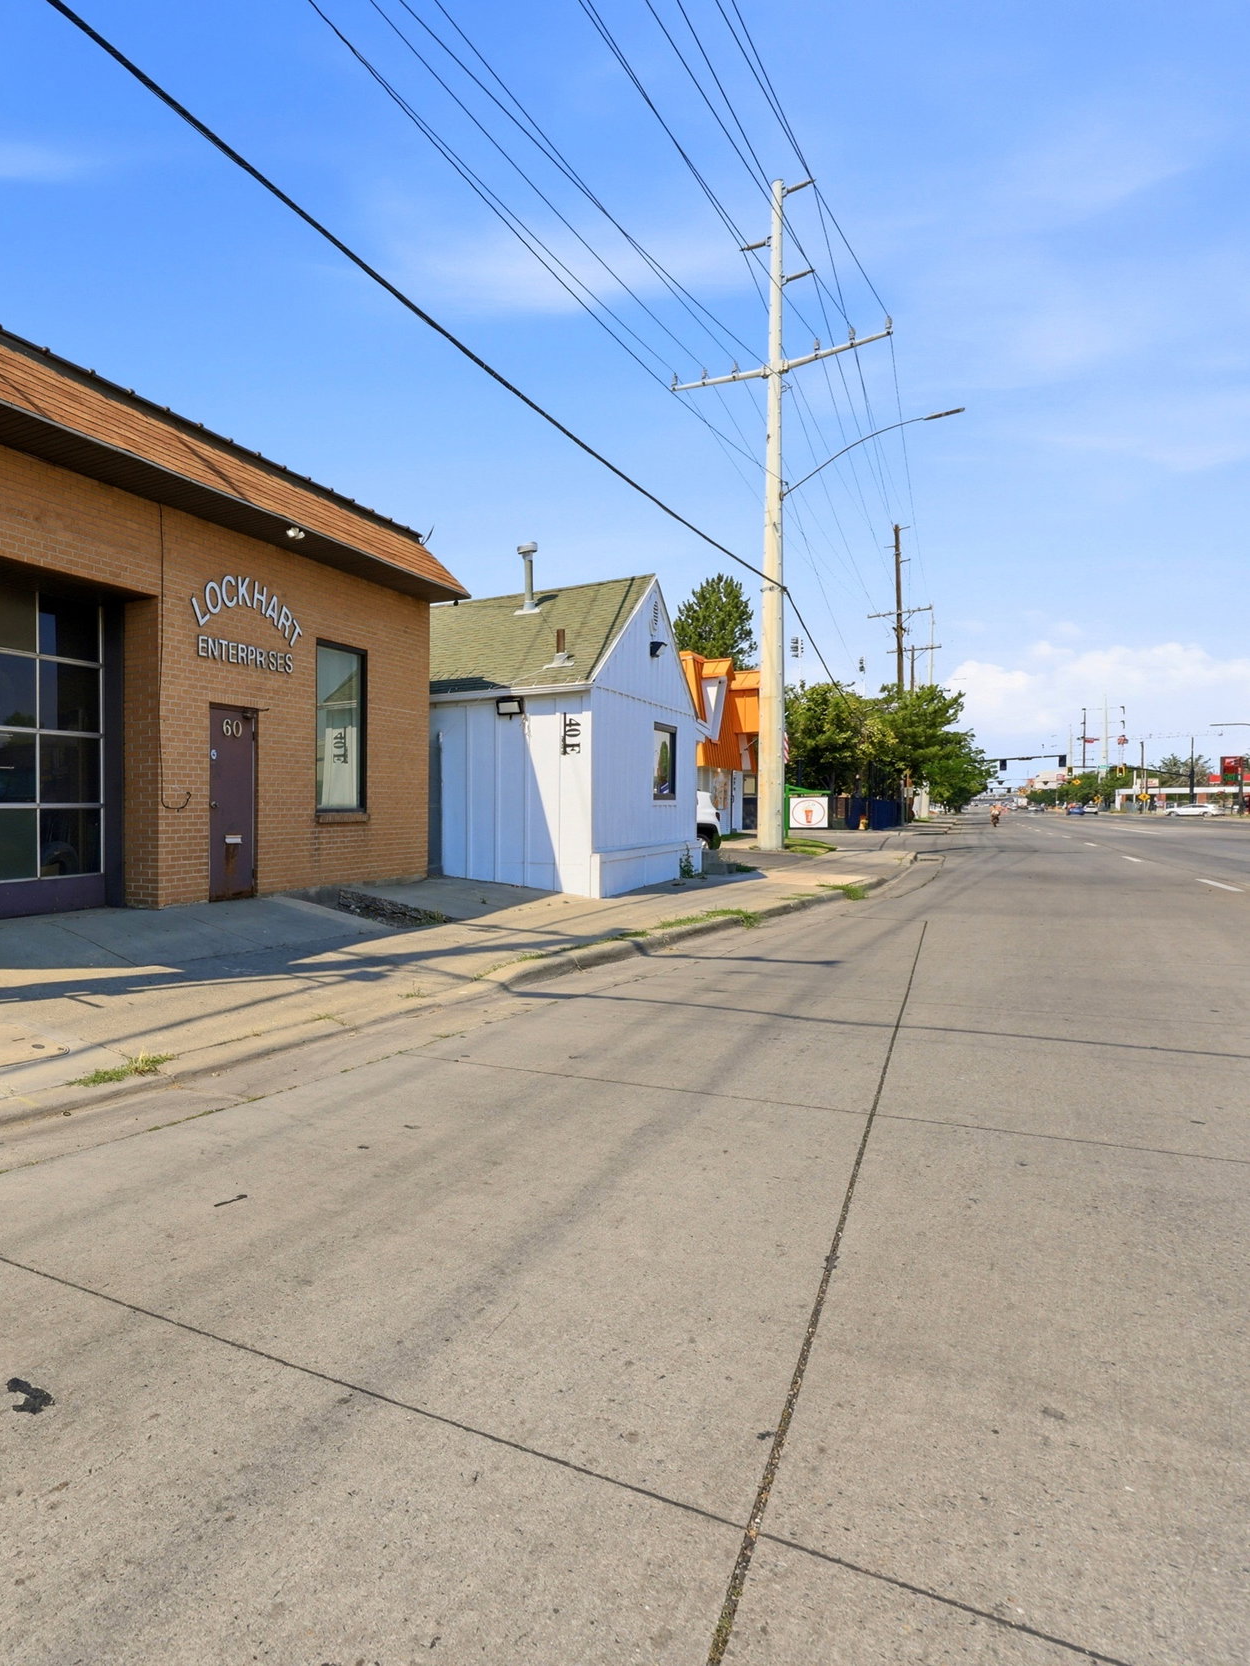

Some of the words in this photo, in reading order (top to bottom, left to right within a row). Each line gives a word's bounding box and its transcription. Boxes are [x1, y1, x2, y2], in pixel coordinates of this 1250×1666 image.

[190, 575, 303, 648] LOCKHART
[222, 718, 243, 738] 60
[565, 717, 581, 738] 40
[565, 742, 581, 756] E
